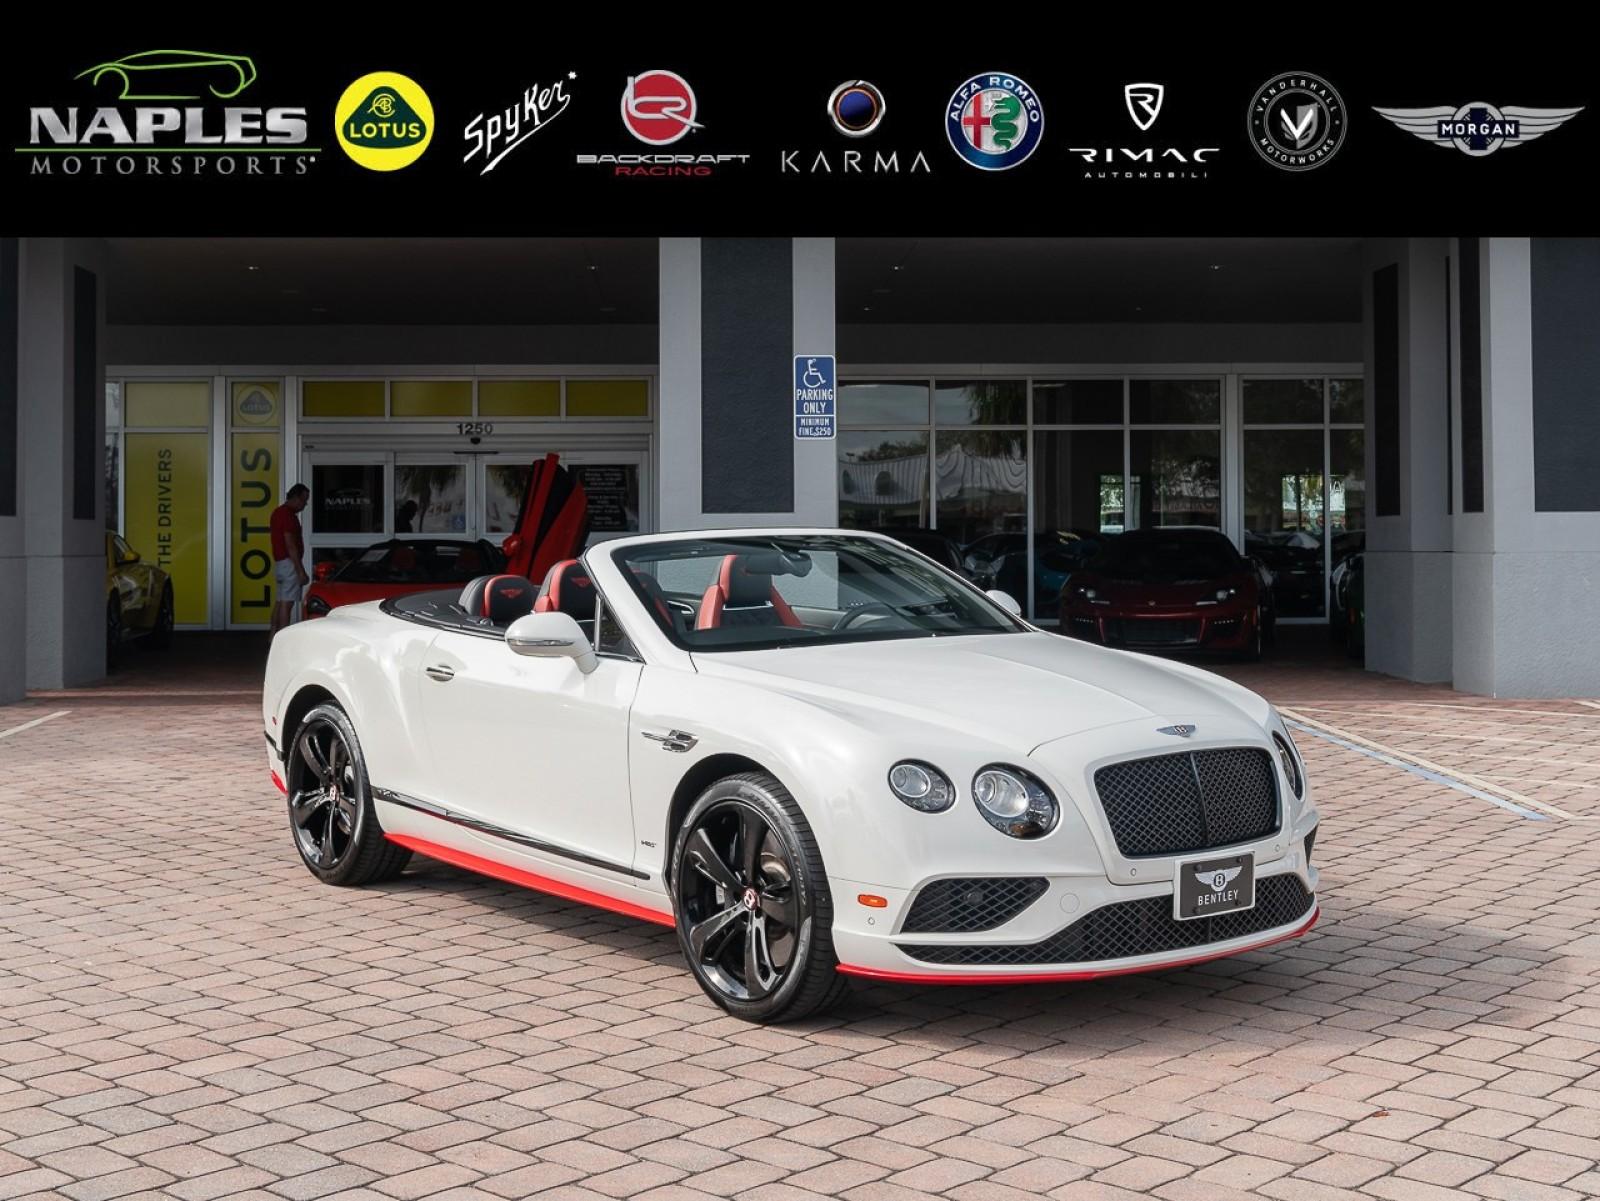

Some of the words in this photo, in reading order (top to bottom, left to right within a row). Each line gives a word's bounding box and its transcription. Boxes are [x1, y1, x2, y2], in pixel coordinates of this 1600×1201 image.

[796, 388, 833, 401] PARKING
[803, 402, 826, 414] ONLY
[456, 422, 493, 435] 1250
[800, 418, 830, 426] MINIMUM
[158, 449, 172, 527] DRIVERS
[240, 448, 271, 608] LOTUS
[158, 535, 172, 567] THE
[1198, 889, 1239, 906] BENTLEY
